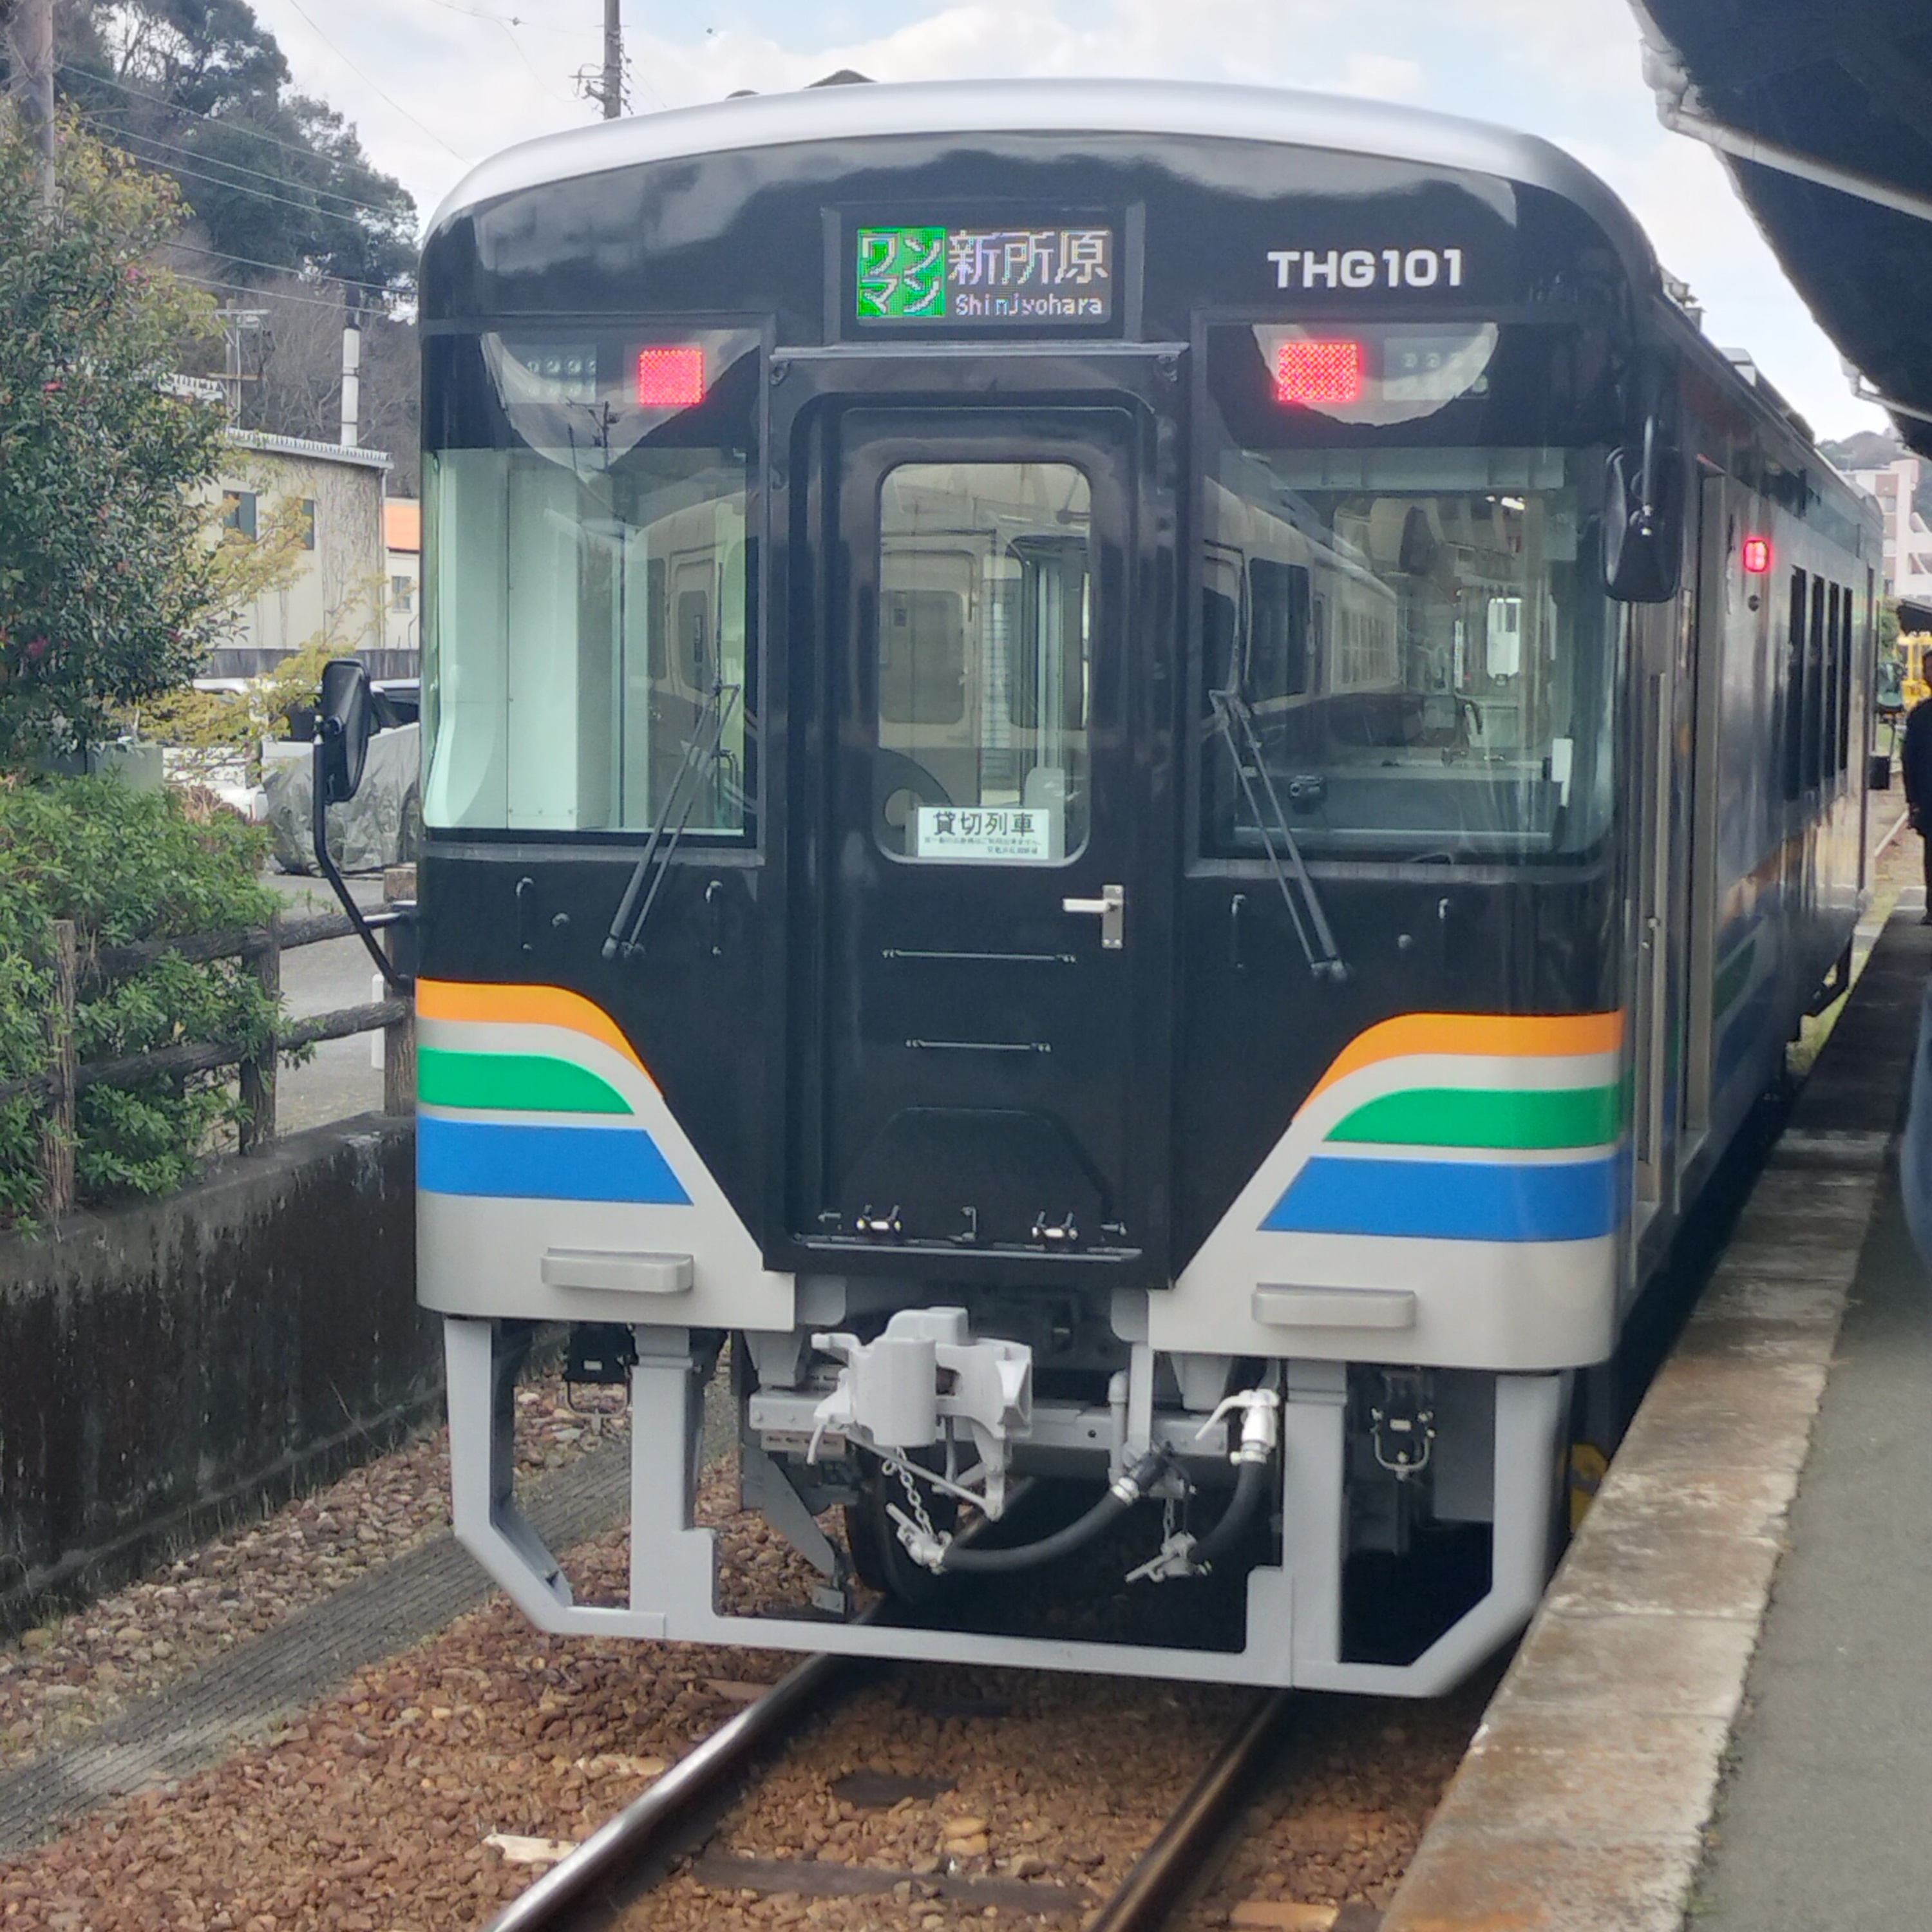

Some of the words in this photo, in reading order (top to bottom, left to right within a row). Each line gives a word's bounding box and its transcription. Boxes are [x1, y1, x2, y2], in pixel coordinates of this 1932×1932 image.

[948, 229, 1109, 285] 新所原
[1267, 249, 1461, 288] THG101
[933, 811, 1035, 837] 貸切列車
